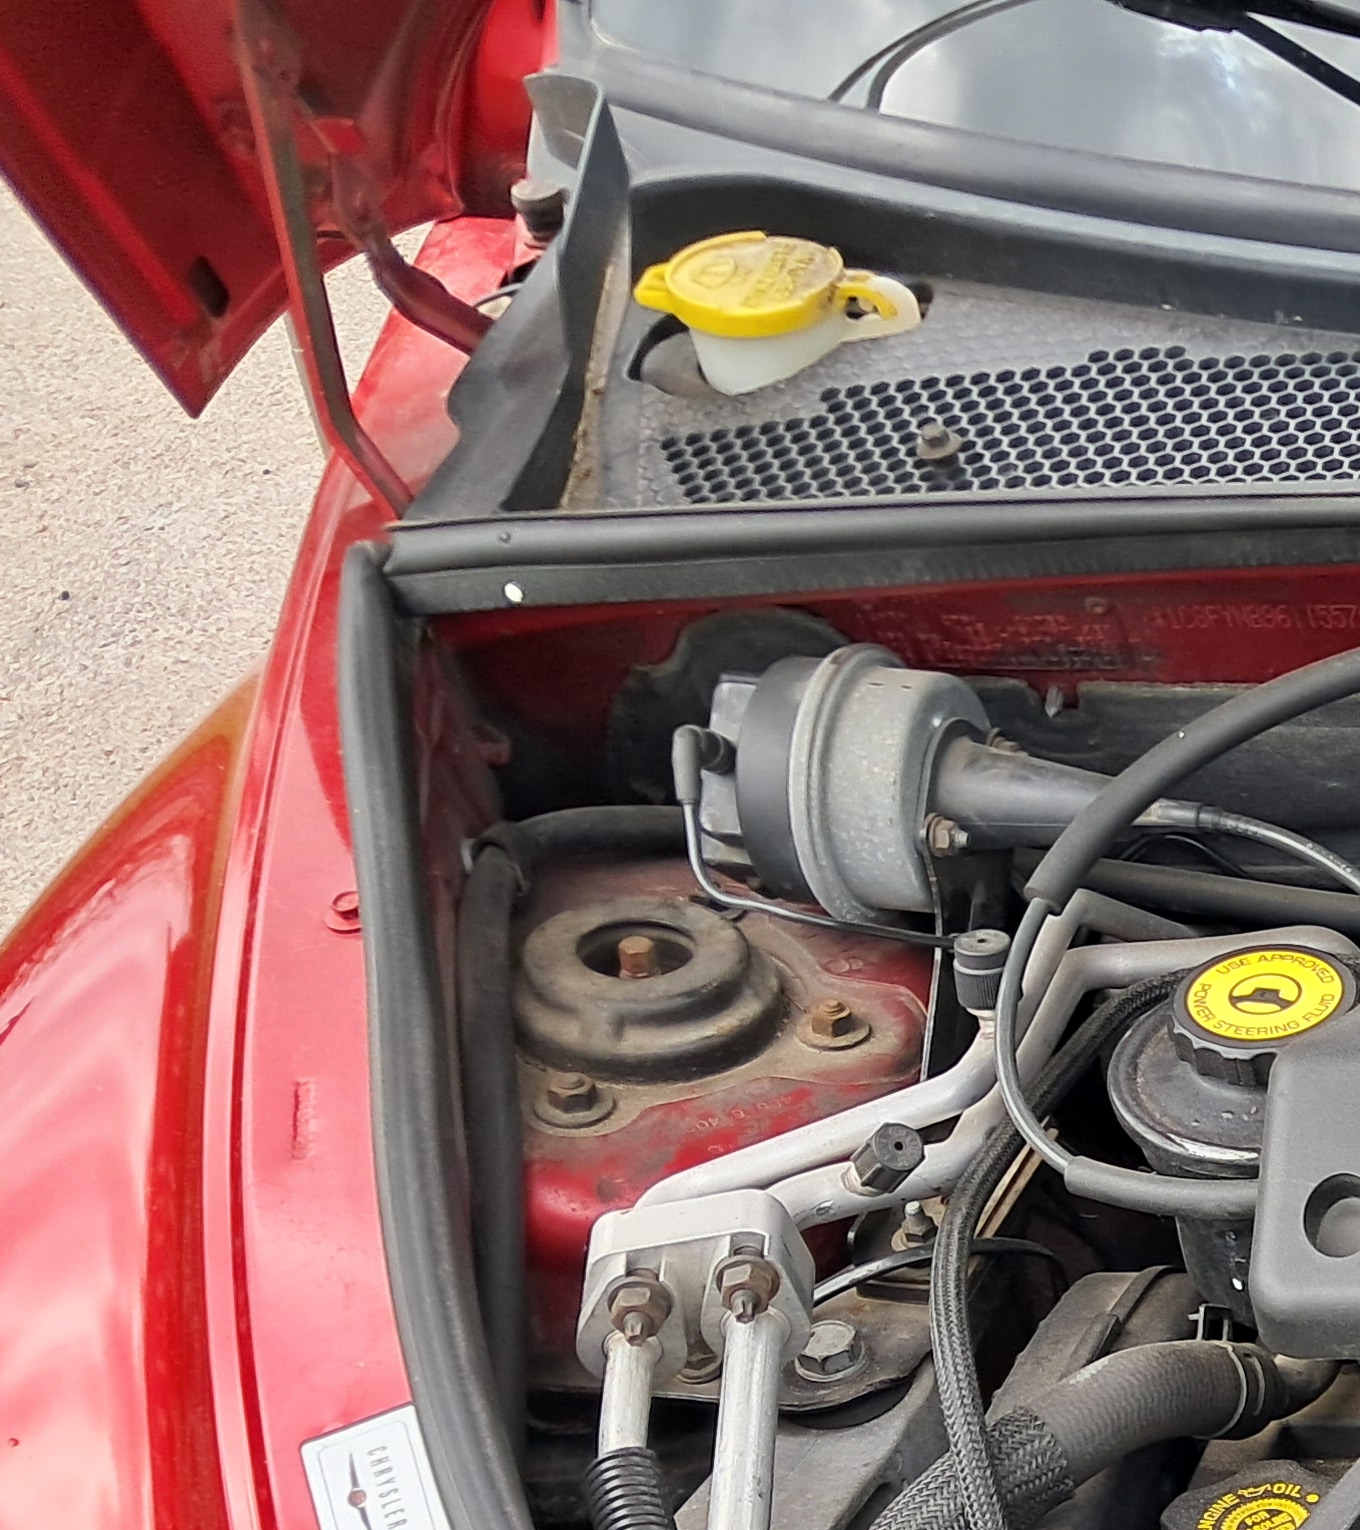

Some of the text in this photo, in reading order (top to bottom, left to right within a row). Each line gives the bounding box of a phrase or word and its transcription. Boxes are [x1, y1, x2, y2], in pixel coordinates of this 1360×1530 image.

[1215, 954, 1335, 984] USE APPROVED
[1194, 983, 1336, 1036] POWER STEERING FLUID
[1272, 1482, 1303, 1498] OIL
